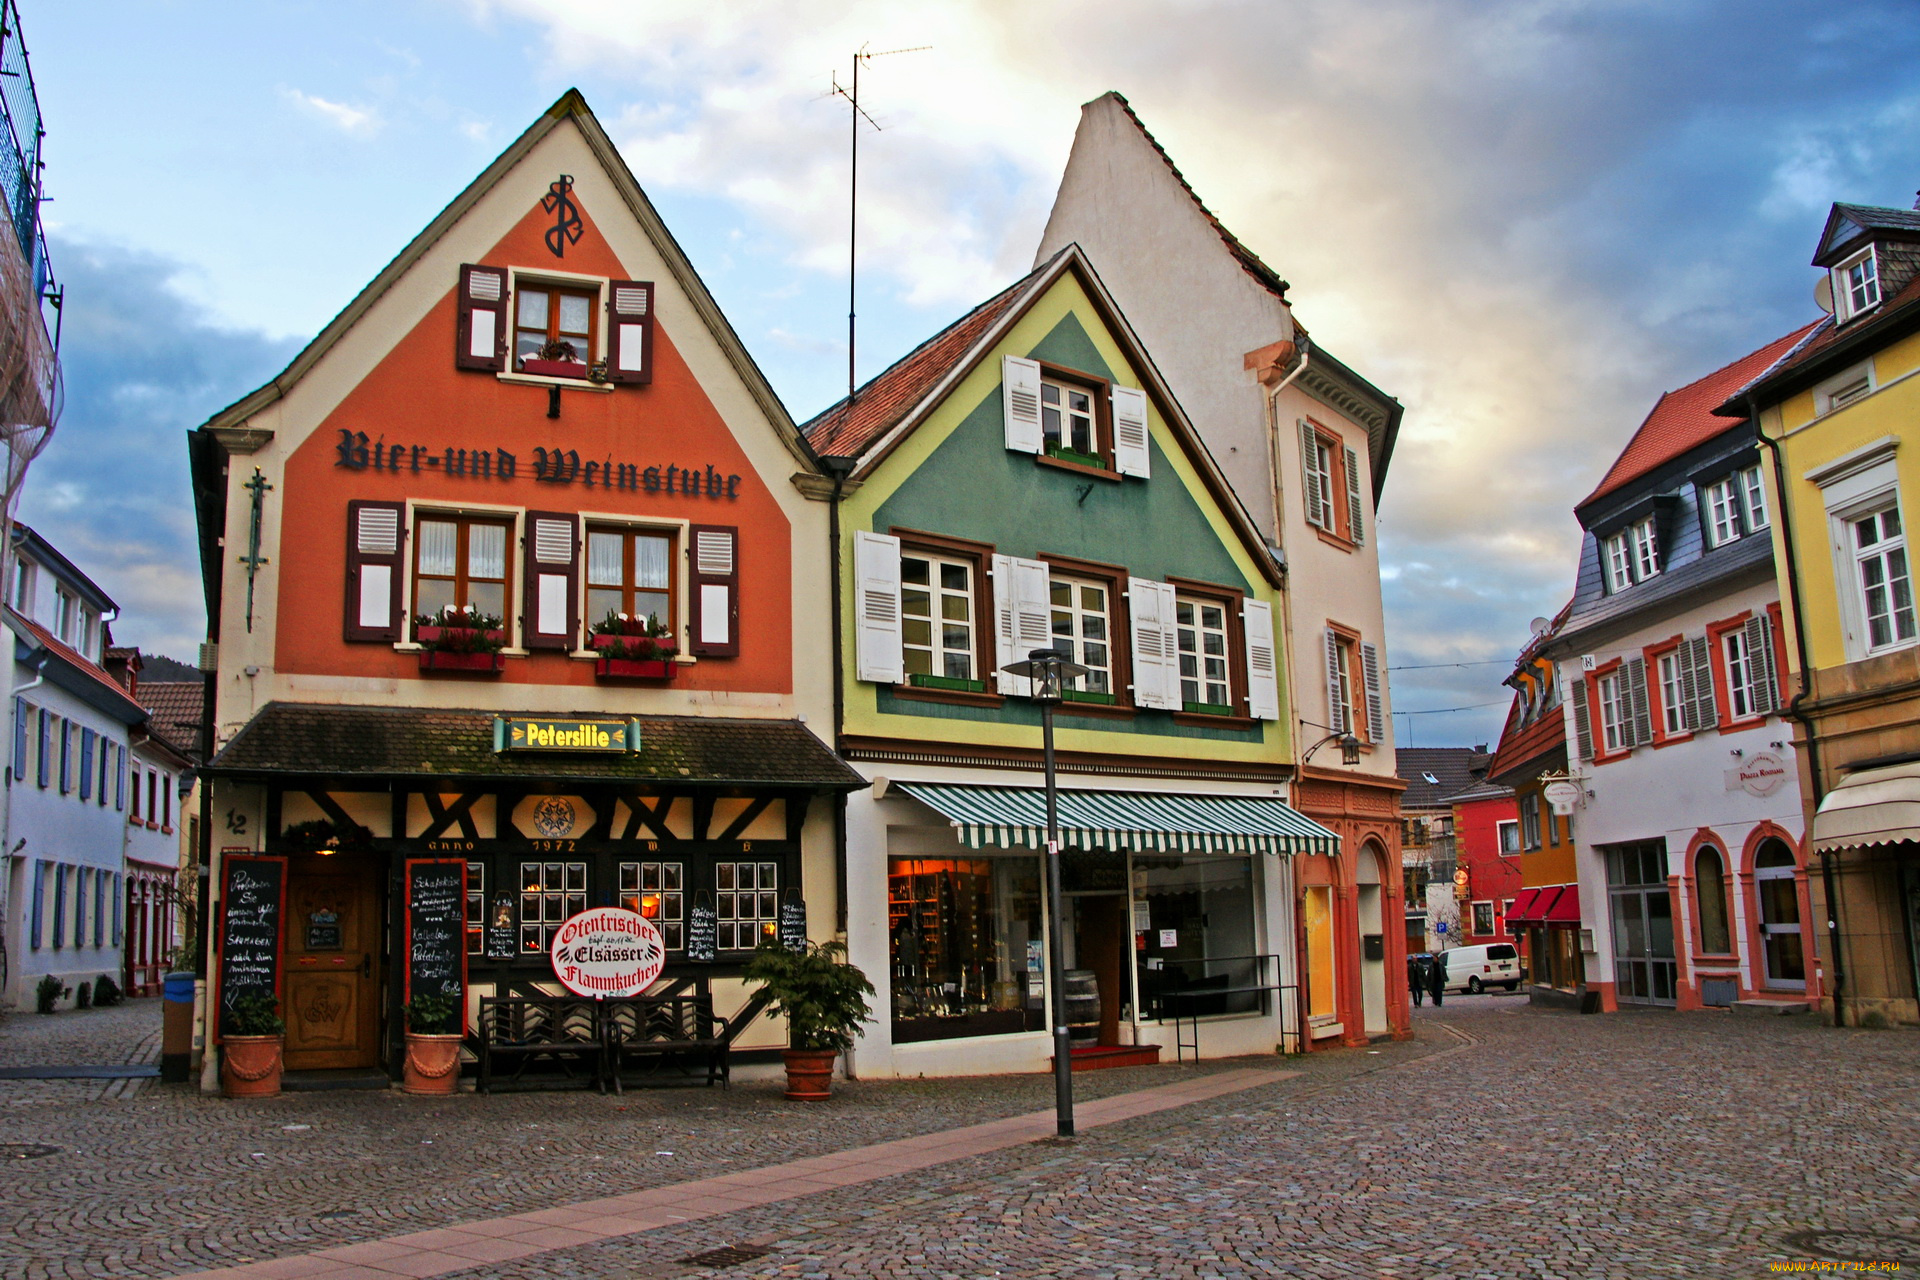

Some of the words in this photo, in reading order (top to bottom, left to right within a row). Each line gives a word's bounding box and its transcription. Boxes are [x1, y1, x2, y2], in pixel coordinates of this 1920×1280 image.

[532, 445, 742, 500] Weinstube
[526, 722, 610, 747] Petersilie
[1739, 771, 1759, 782] Piazza
[1759, 768, 1785, 778] Romana
[226, 807, 247, 835] 12
[428, 840, 475, 851] anno
[532, 840, 576, 852] 1972
[238, 891, 258, 904] Sie
[561, 912, 656, 945] Ofenfrischer
[1438, 923, 1445, 932] P
[227, 933, 273, 947] SAUMAGEN
[574, 945, 644, 963] Elsässer
[561, 962, 659, 991] Flammkuchen
